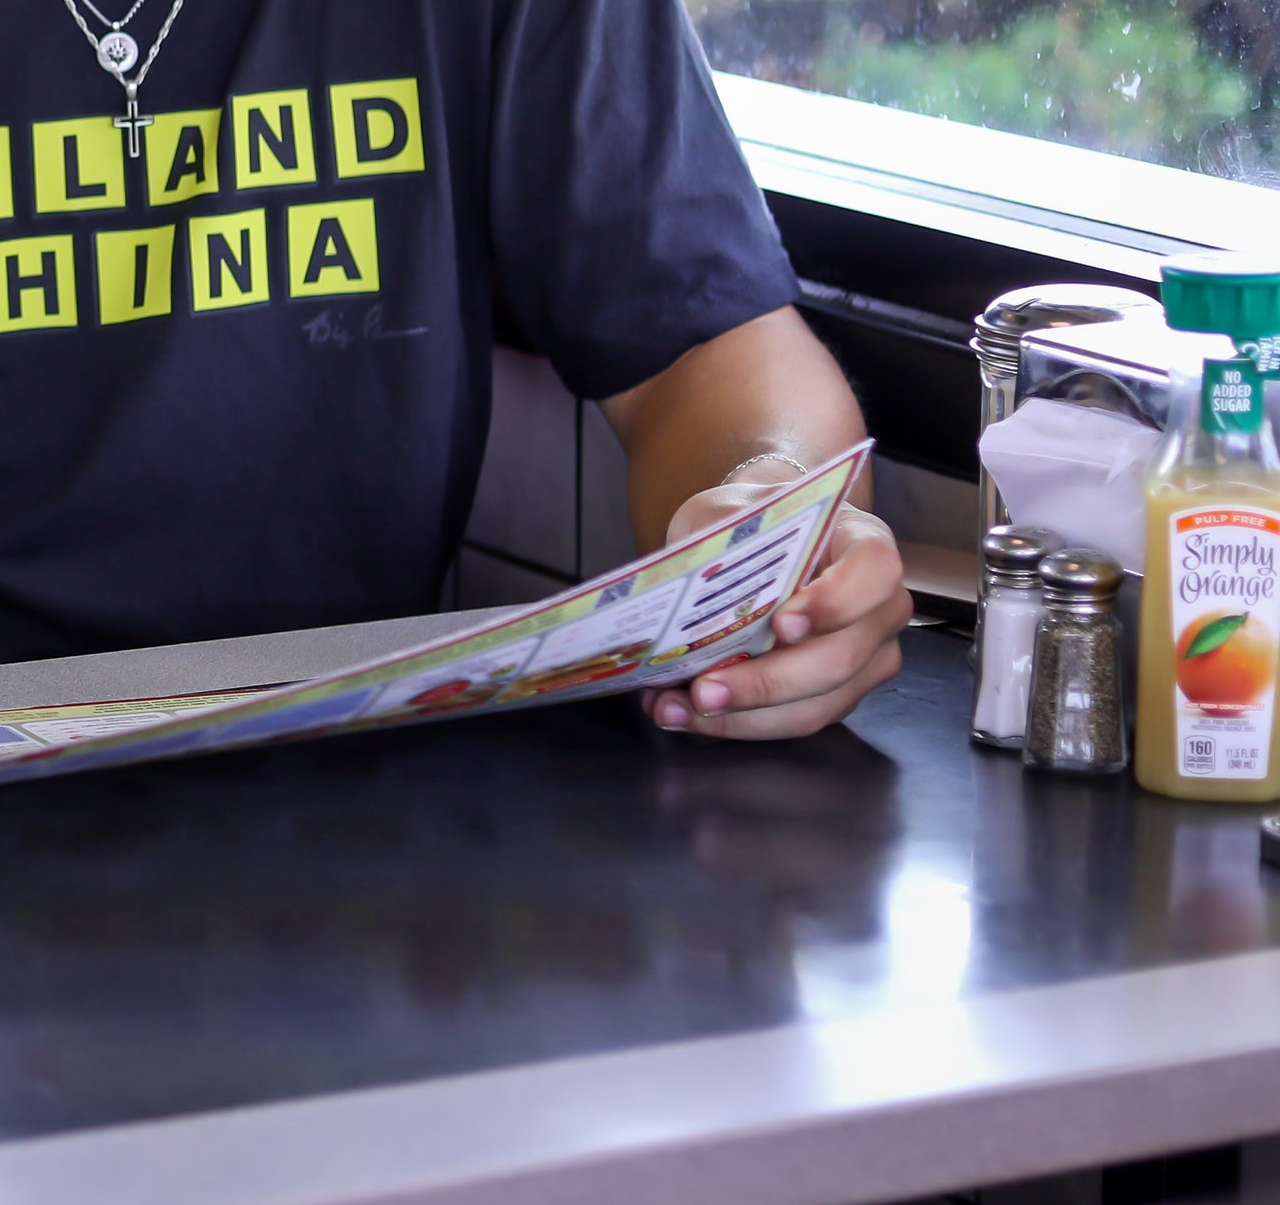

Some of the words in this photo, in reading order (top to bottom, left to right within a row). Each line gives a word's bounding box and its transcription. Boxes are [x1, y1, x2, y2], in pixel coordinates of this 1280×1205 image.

[1225, 371, 1241, 384] NO
[1213, 384, 1252, 397] ADDED
[1213, 398, 1251, 412] SUGAR
[1194, 514, 1229, 525] PULP
[1232, 515, 1266, 527] FREE
[1182, 532, 1277, 577] Simply
[1179, 570, 1274, 606] Orange
[1189, 740, 1212, 756] 160
